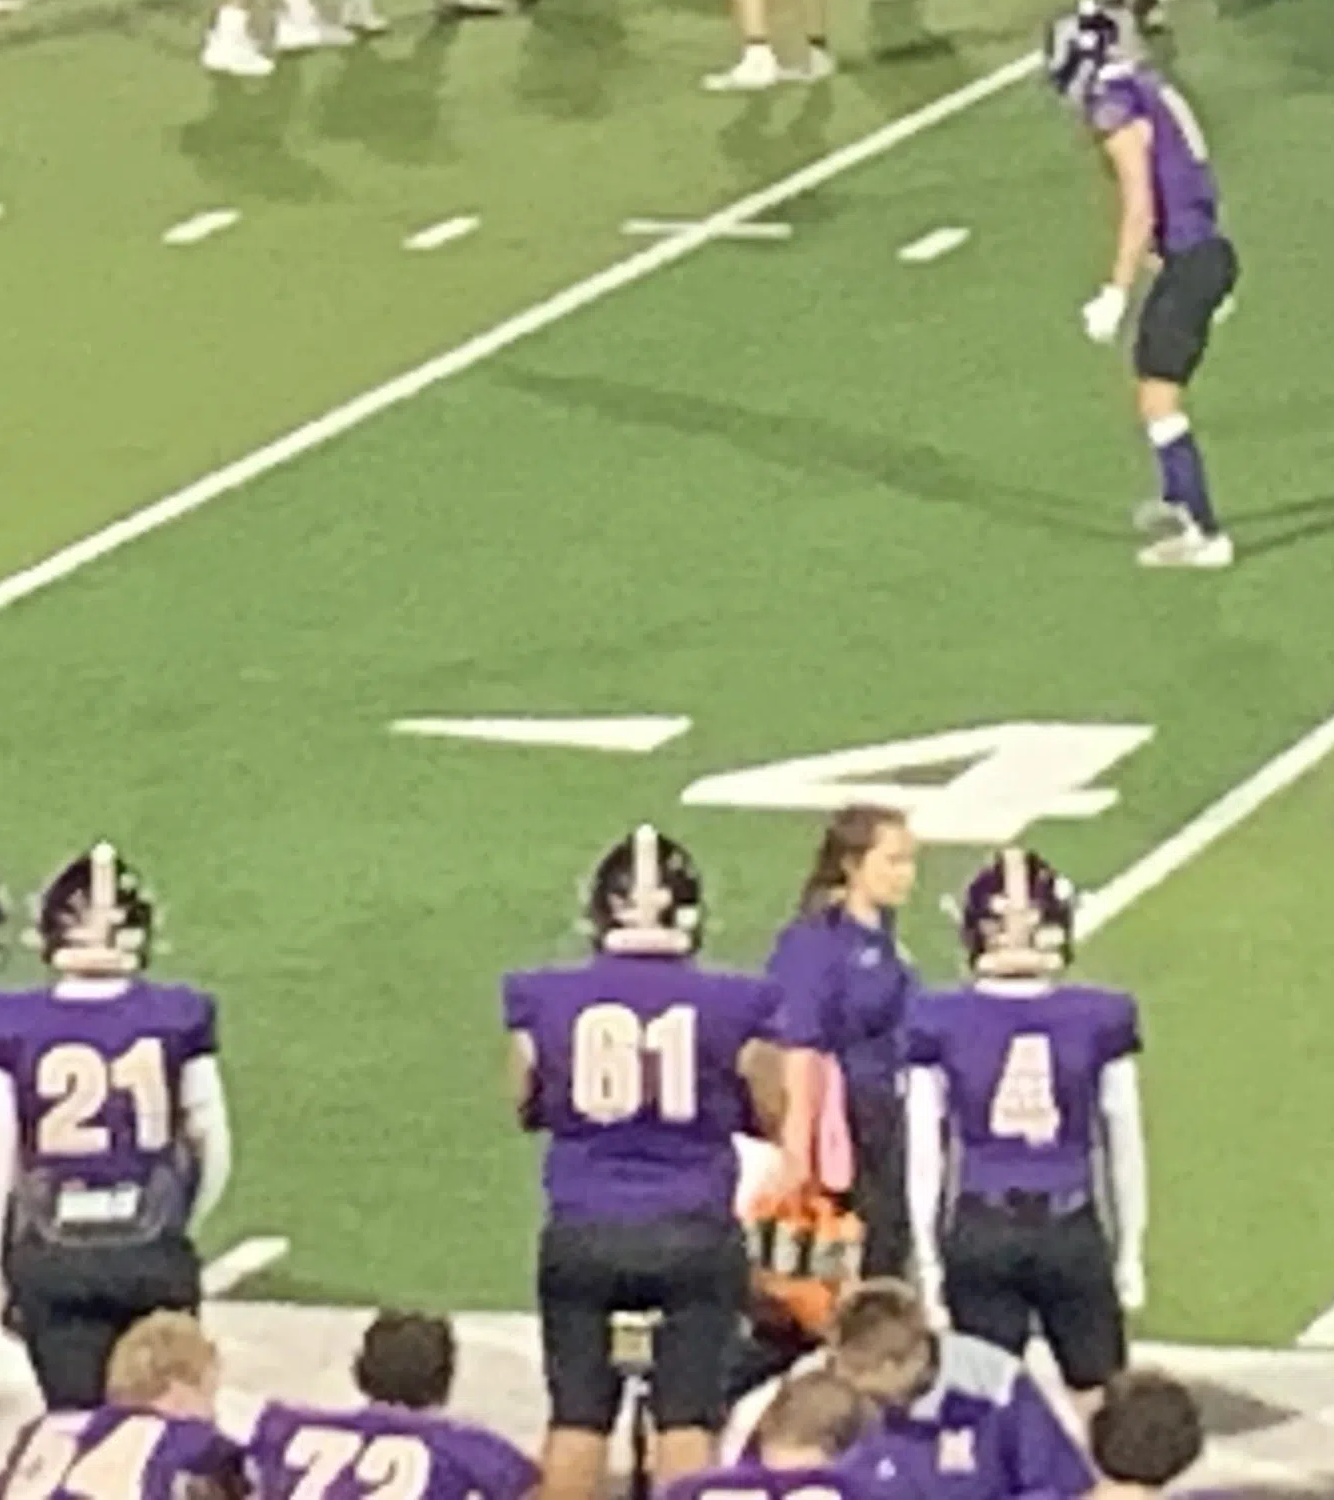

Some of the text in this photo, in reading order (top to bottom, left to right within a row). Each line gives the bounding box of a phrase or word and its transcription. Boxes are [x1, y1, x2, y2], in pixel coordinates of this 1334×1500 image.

[37, 1037, 170, 1155] 21
[571, 1004, 697, 1124] 61
[990, 1033, 1060, 1146] 4
[285, 1426, 430, 1500] 72
